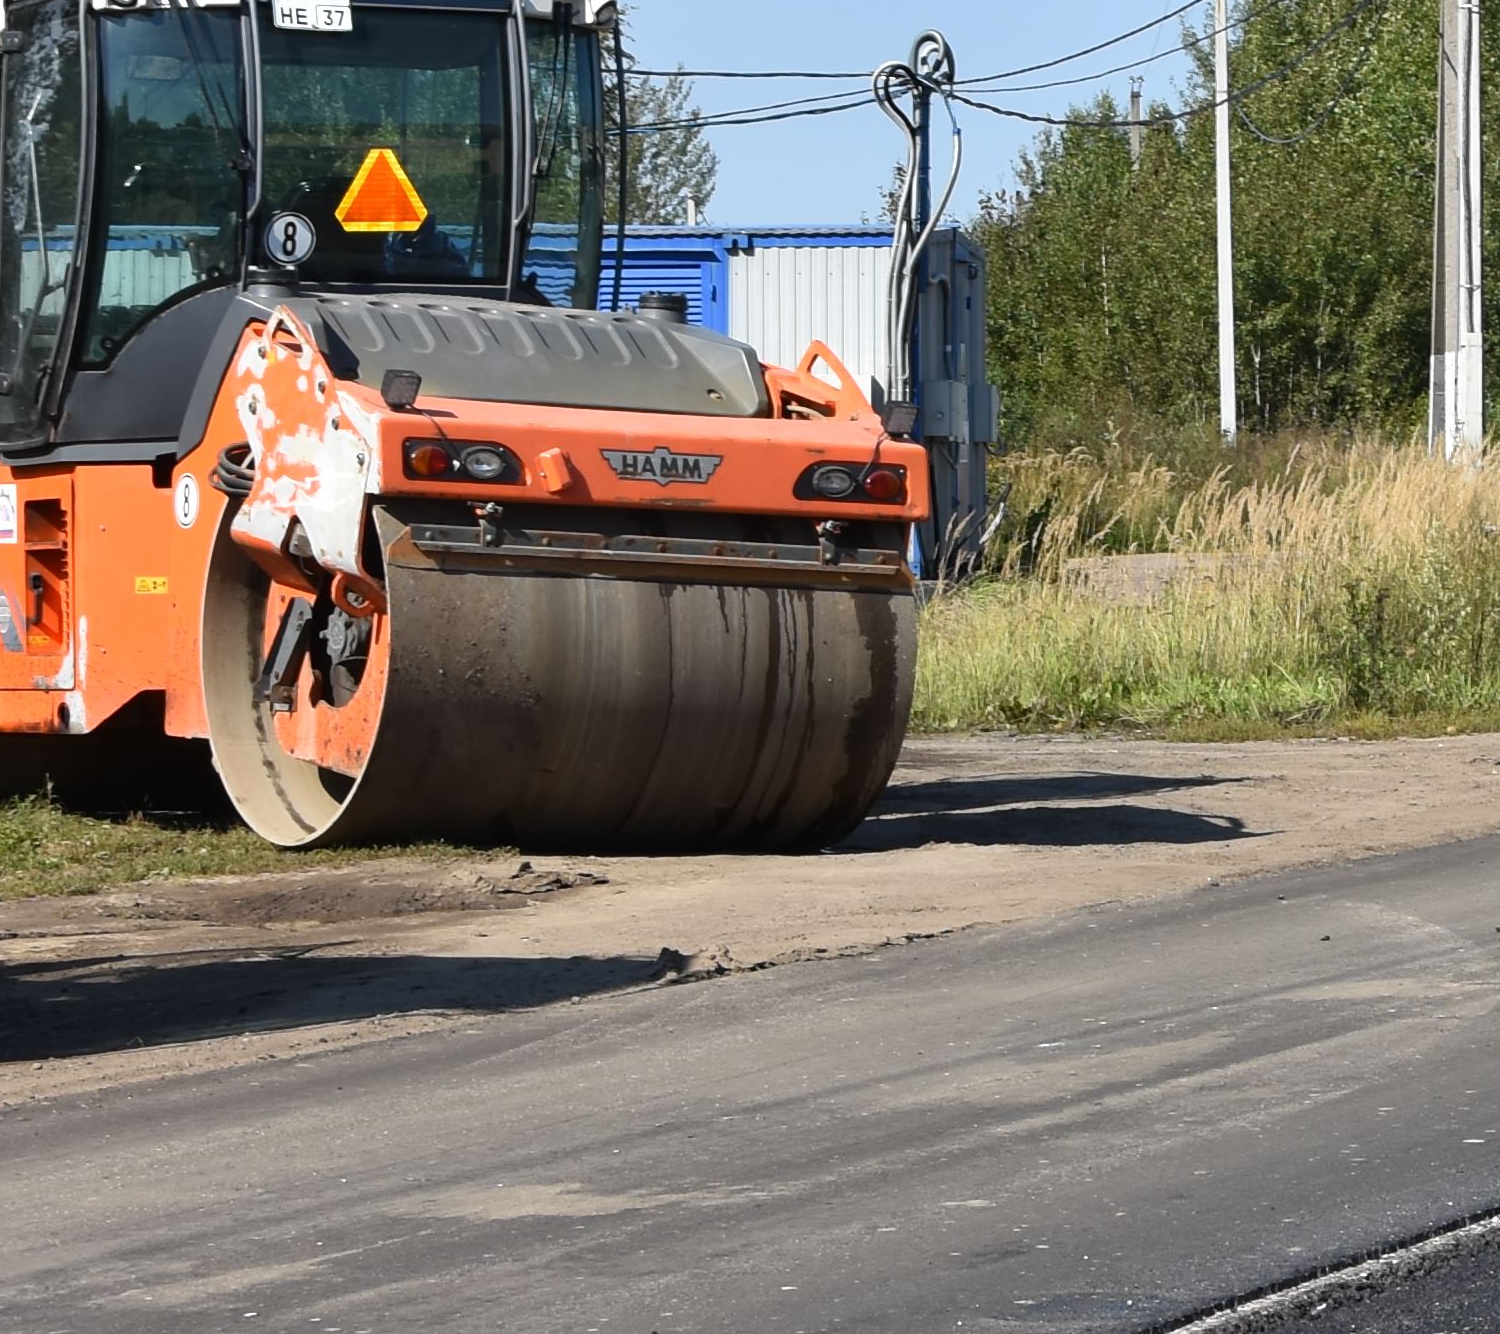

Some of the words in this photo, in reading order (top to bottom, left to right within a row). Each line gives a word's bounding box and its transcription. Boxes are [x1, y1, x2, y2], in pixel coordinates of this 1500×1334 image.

[322, 9, 345, 26] 37
[282, 221, 297, 257] 8
[621, 454, 703, 480] HAMM
